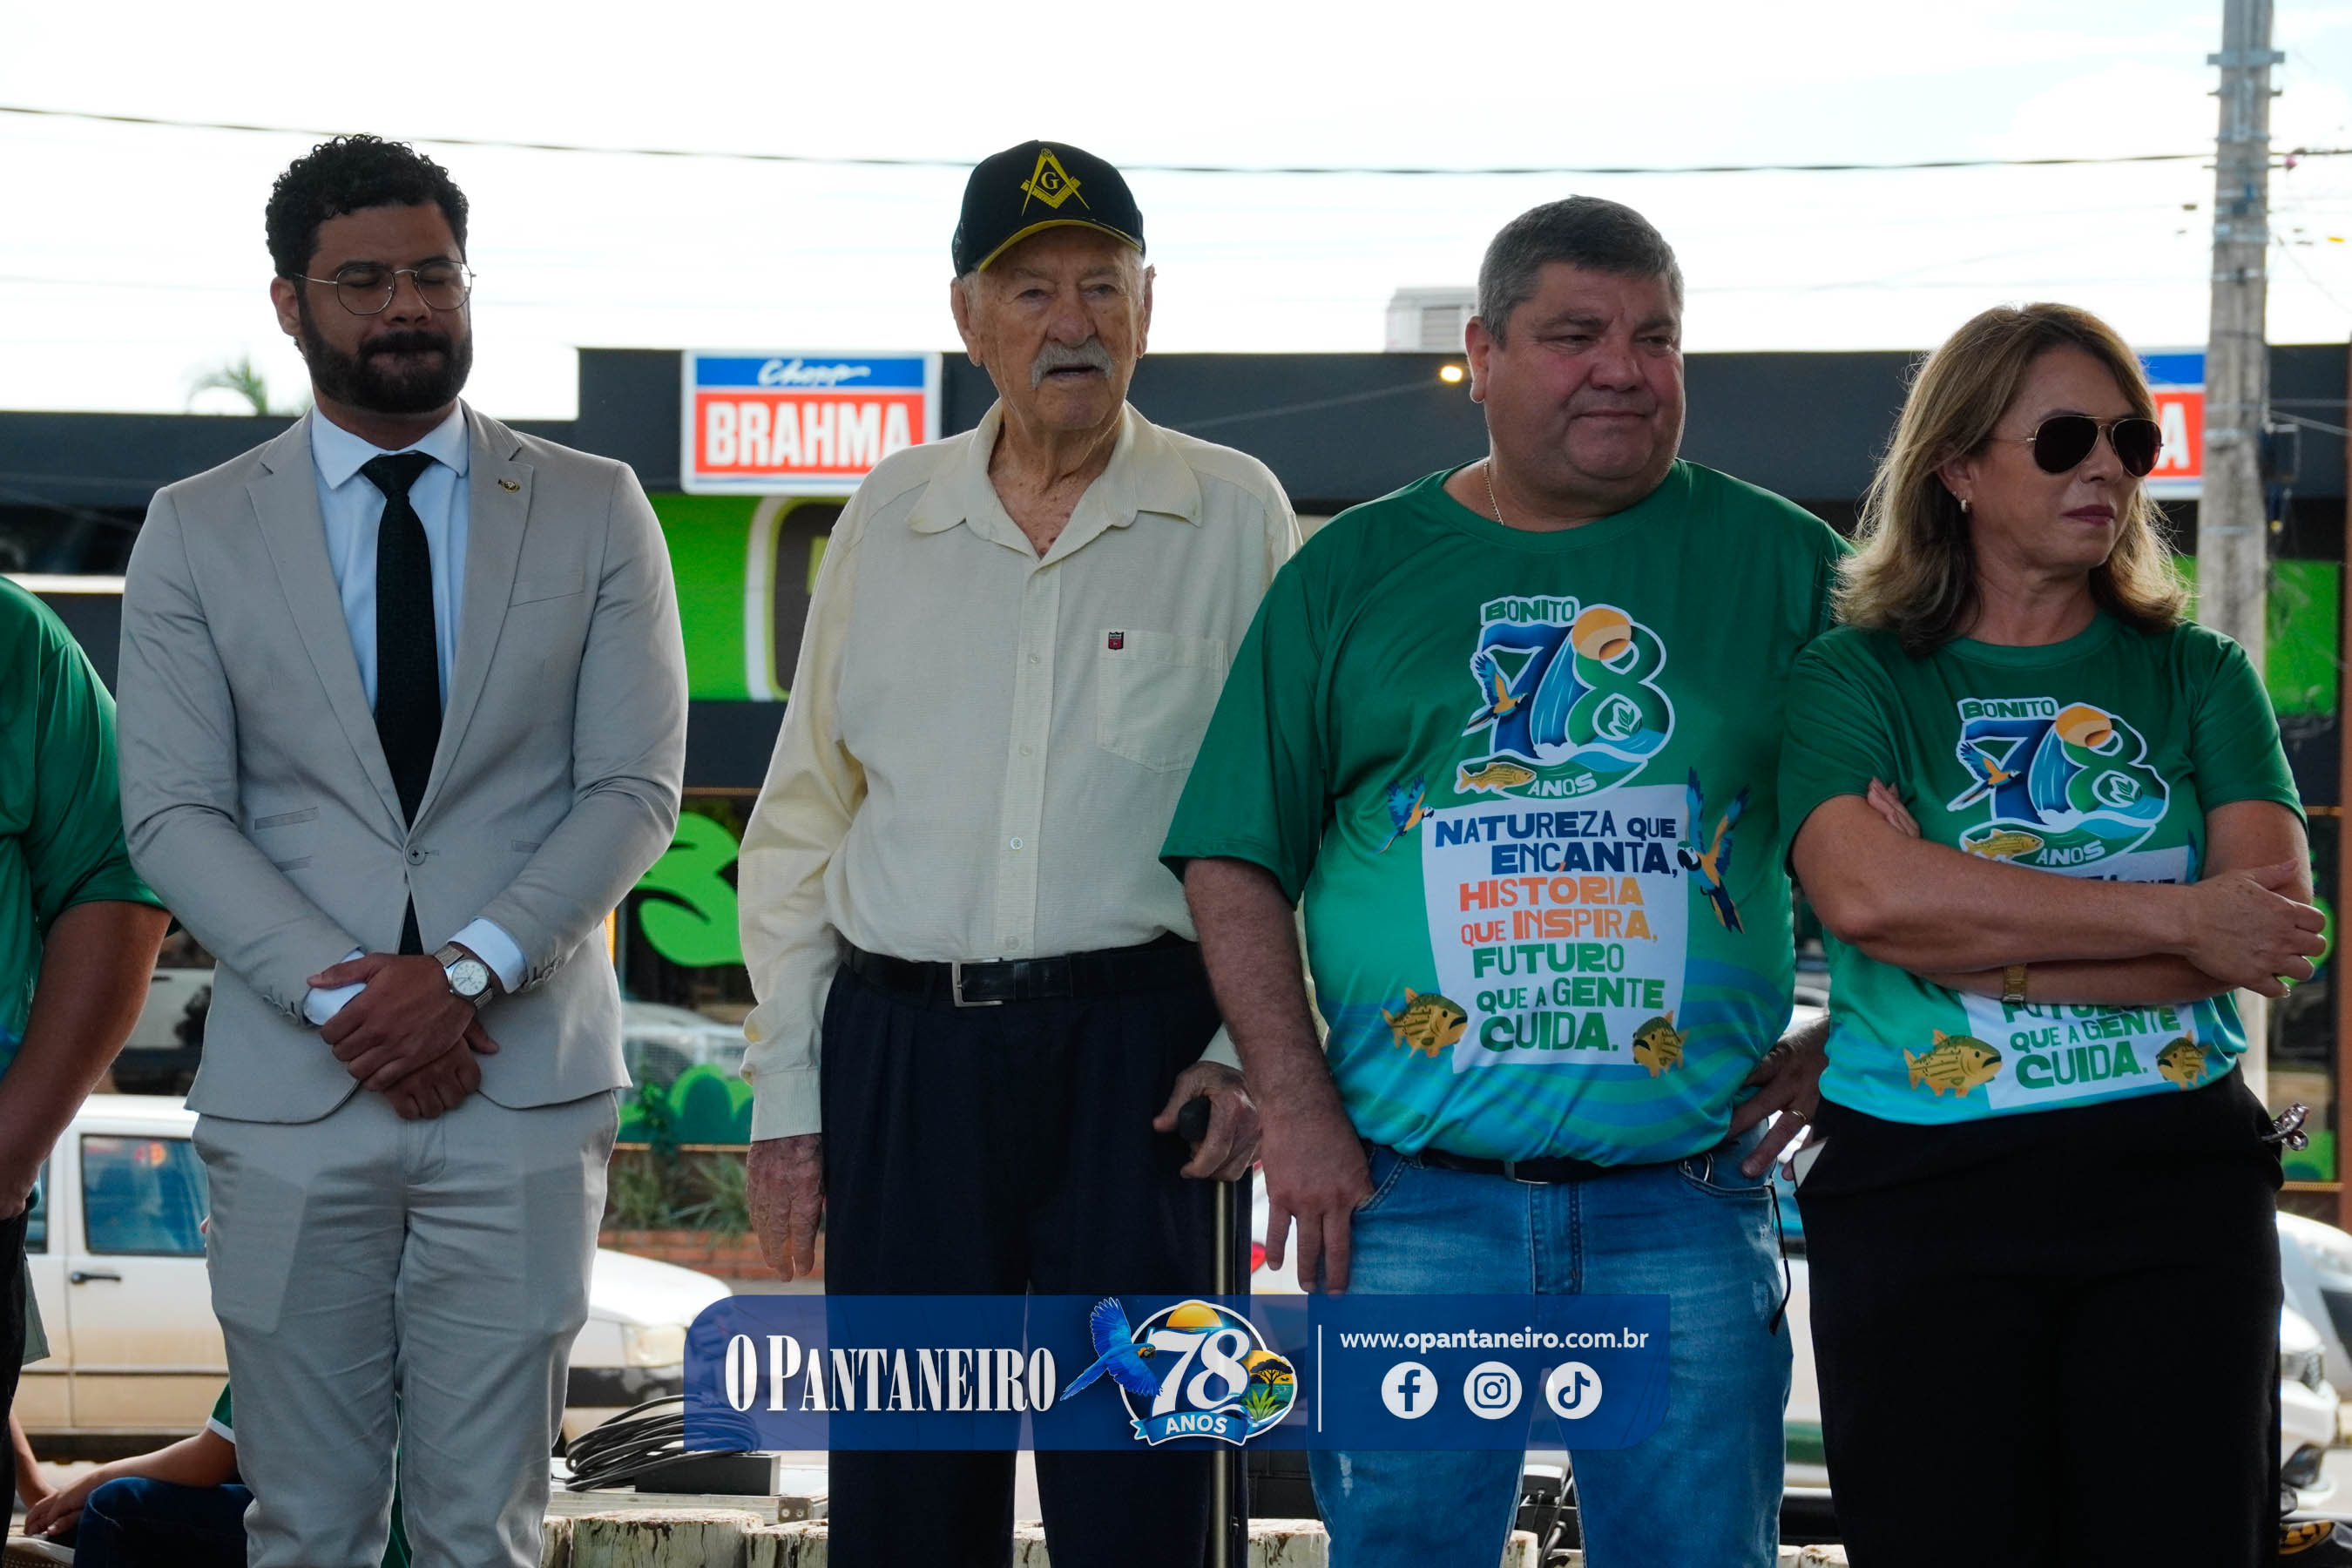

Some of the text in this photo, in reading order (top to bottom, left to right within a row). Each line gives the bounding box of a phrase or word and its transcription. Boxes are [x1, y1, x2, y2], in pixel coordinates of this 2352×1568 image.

[1040, 172, 1059, 189] G
[705, 401, 914, 467] BRAHMA
[1484, 598, 1576, 624] BONITO
[1480, 608, 1675, 761] 78
[1962, 699, 2056, 719] BONITO
[1962, 704, 2169, 828] 78
[1527, 772, 1597, 798] ANOS
[1435, 809, 1677, 848] NATUREZA QUE
[1490, 841, 1678, 878] ENCANTA,
[2035, 839, 2105, 866] ANOS
[1460, 920, 1506, 947] QUE
[1472, 942, 1625, 978] FUTURO
[1476, 977, 1666, 1015] QUE A GENTE
[1479, 1011, 1619, 1053] CUIDA.
[2009, 1006, 2181, 1053] QUE A GENTE
[2015, 1040, 2149, 1090] CUIDA.
